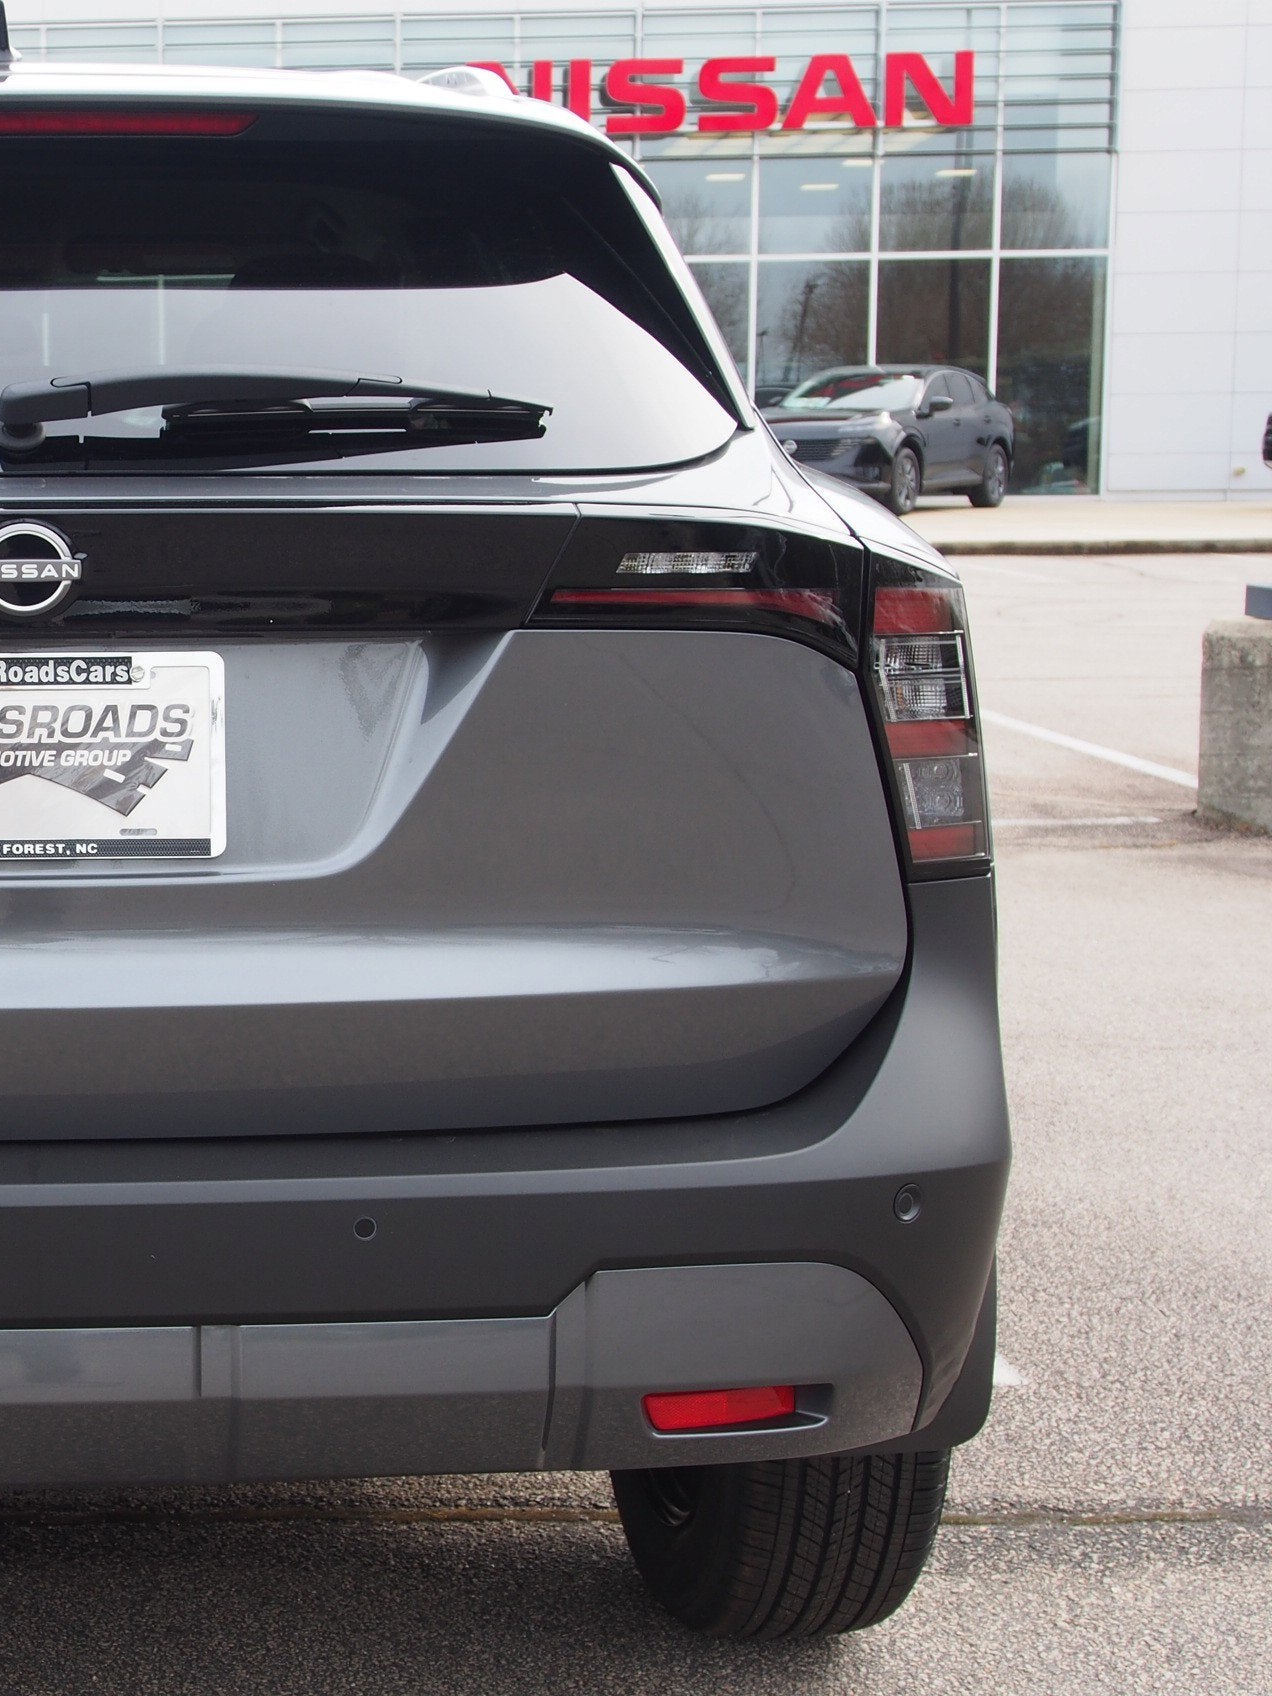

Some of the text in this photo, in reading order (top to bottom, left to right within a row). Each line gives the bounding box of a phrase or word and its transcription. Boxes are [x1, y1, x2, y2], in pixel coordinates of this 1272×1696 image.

[59, 749, 132, 766] GROUP
[3, 843, 71, 855] FOREST,
[76, 843, 98, 853] NC
